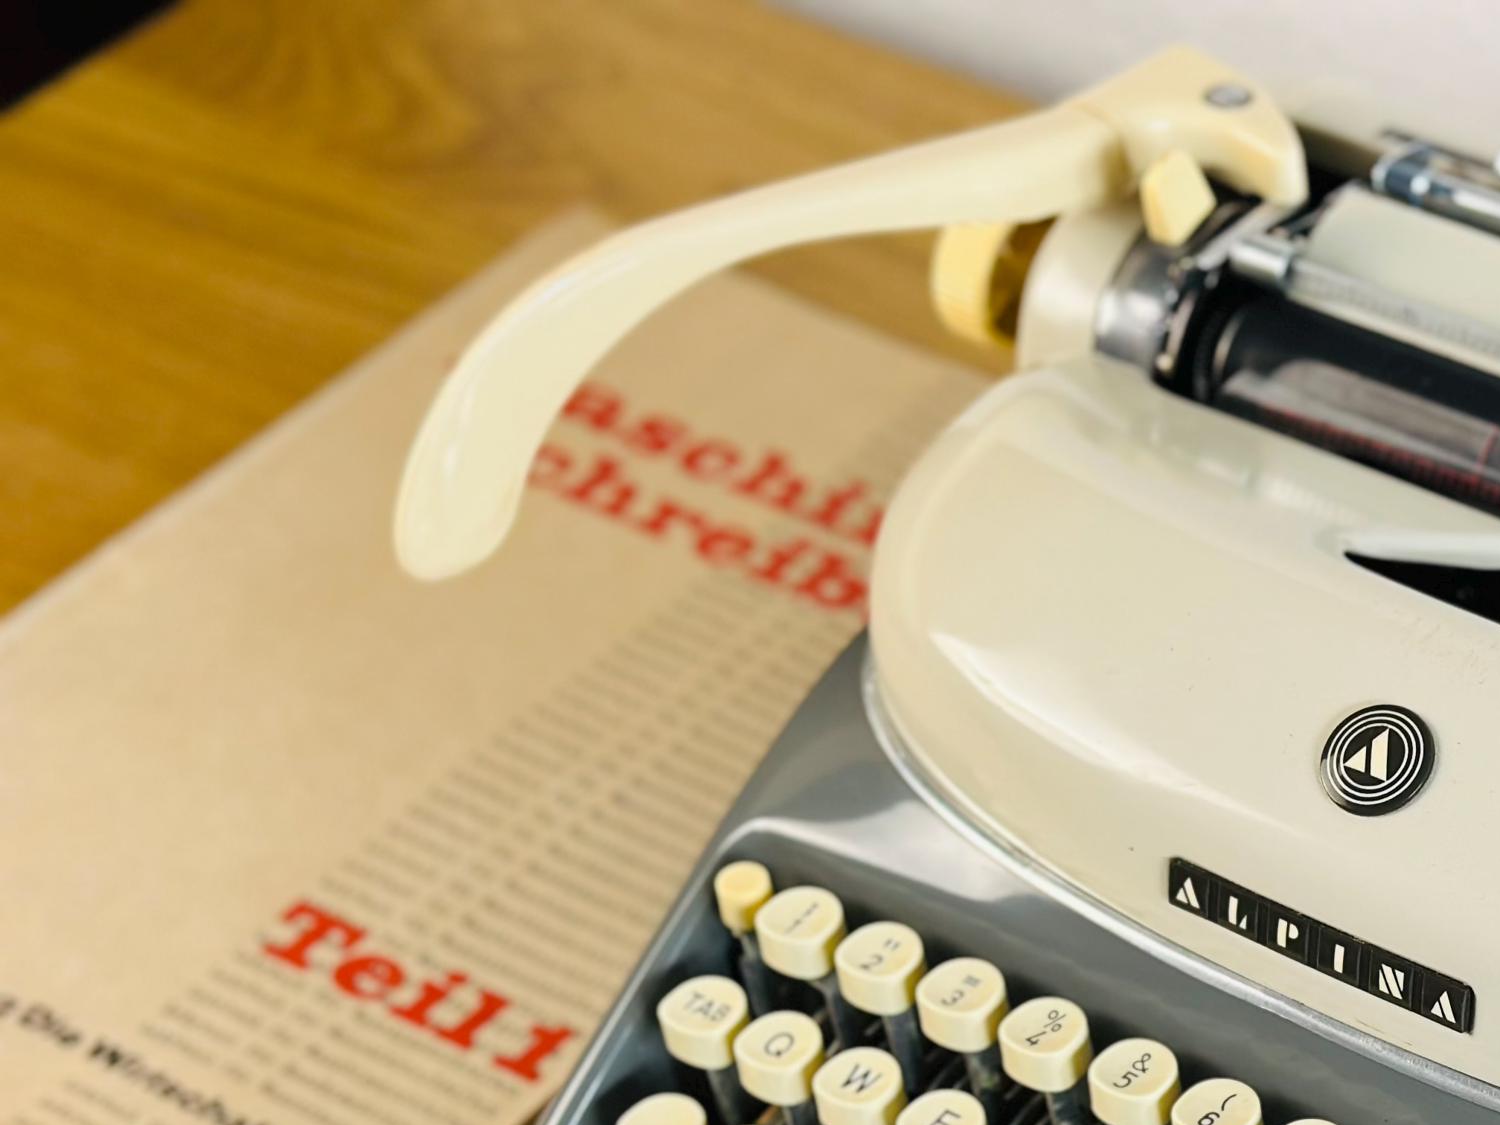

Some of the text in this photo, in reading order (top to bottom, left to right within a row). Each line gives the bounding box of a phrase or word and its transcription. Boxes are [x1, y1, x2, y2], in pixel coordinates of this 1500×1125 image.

[526, 440, 868, 622] chreib
[261, 899, 511, 1050] Teil
[1175, 876, 1457, 1024] ALPINA
[683, 991, 731, 1022] TAB
[765, 1034, 794, 1057] Q
[841, 1064, 881, 1094] W
